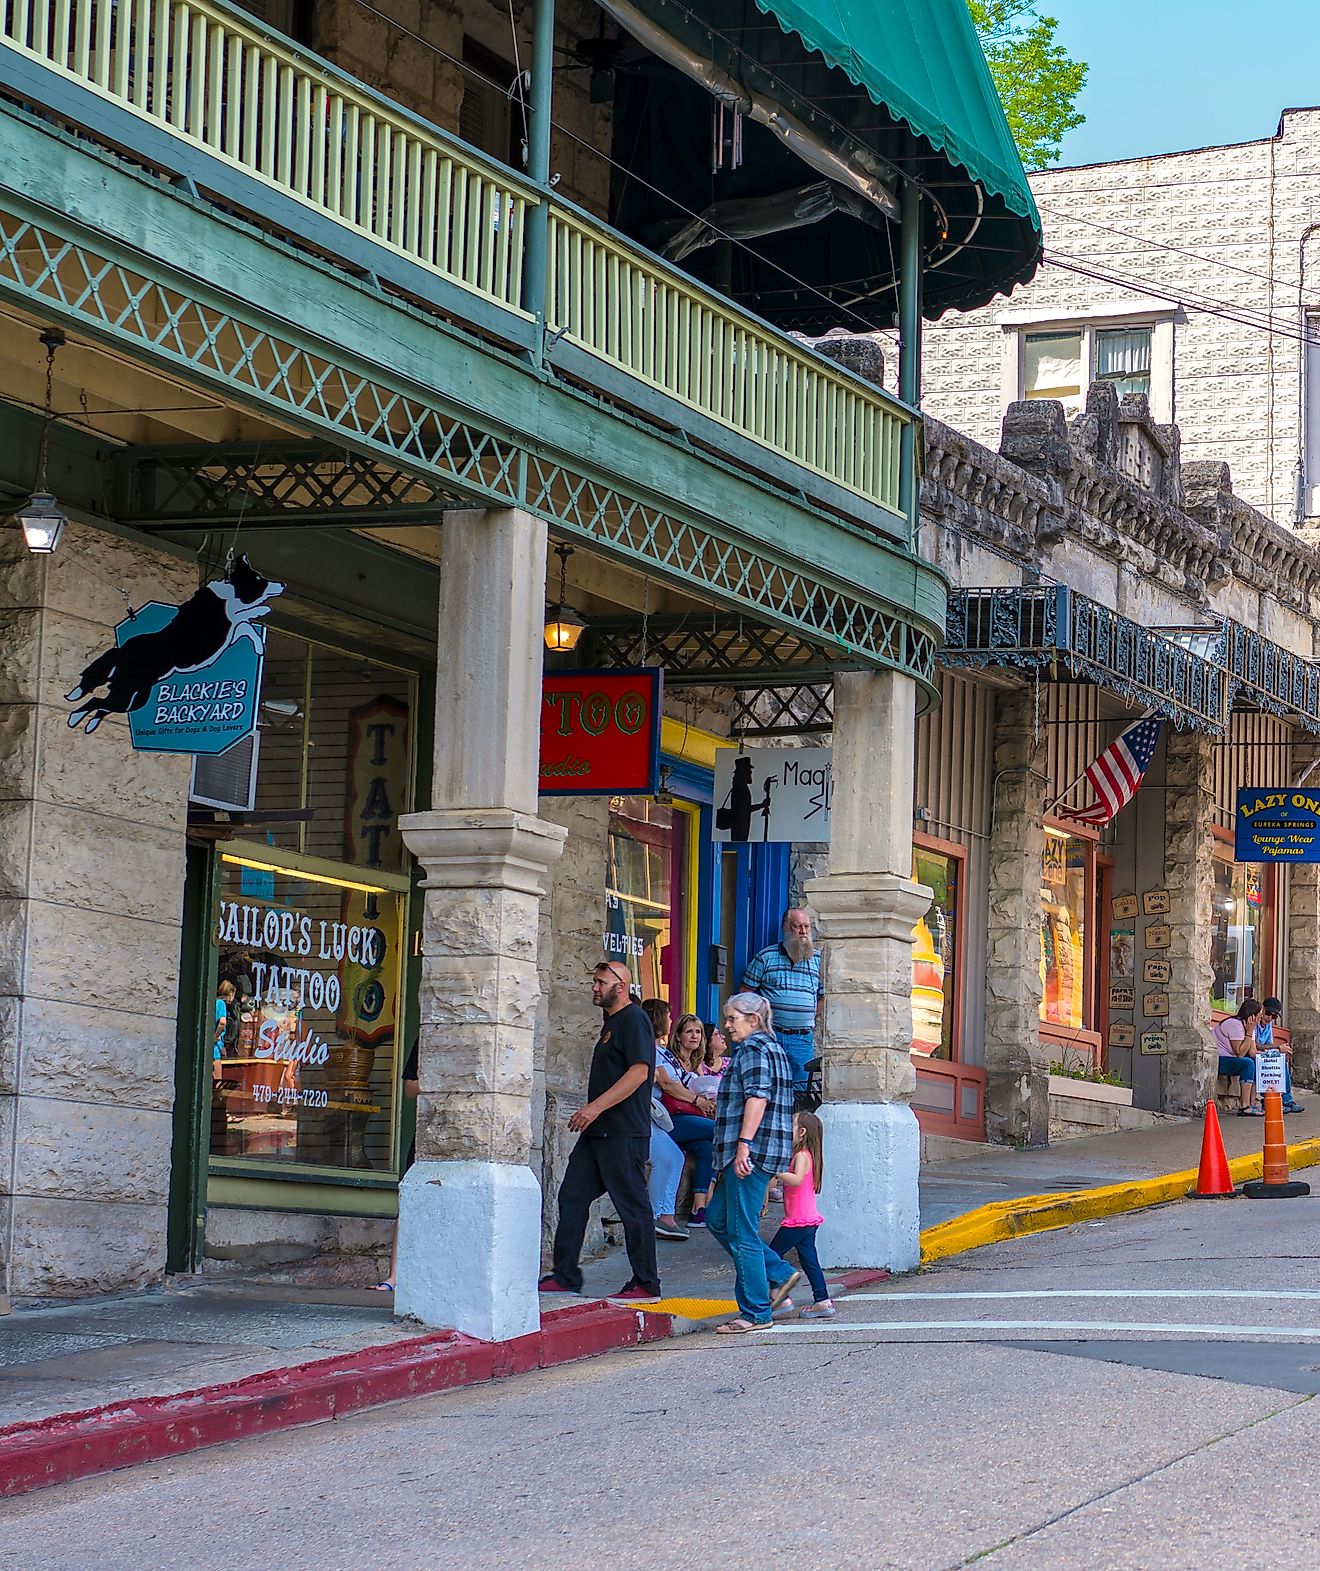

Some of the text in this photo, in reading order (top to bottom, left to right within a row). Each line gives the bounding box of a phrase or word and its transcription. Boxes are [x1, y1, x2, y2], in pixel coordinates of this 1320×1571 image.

[157, 680, 246, 702] BLACKIE'S
[154, 701, 245, 724] BACKYARD
[543, 690, 646, 736] TOO
[135, 728, 156, 736] Unique
[158, 726, 173, 735] Gifts
[186, 726, 200, 735] Dogs
[209, 726, 221, 735] Dog
[222, 724, 244, 733] Lovers
[1239, 794, 1287, 818] LAZY
[1254, 821, 1282, 829] EUREKA
[1252, 834, 1315, 845] Lounge Wear
[1262, 846, 1304, 857] Pajamas
[319, 920, 377, 966] LUCK
[252, 962, 342, 1013] TATTOO
[255, 1019, 330, 1066] Studio
[252, 1084, 328, 1108] 479-244-7220
